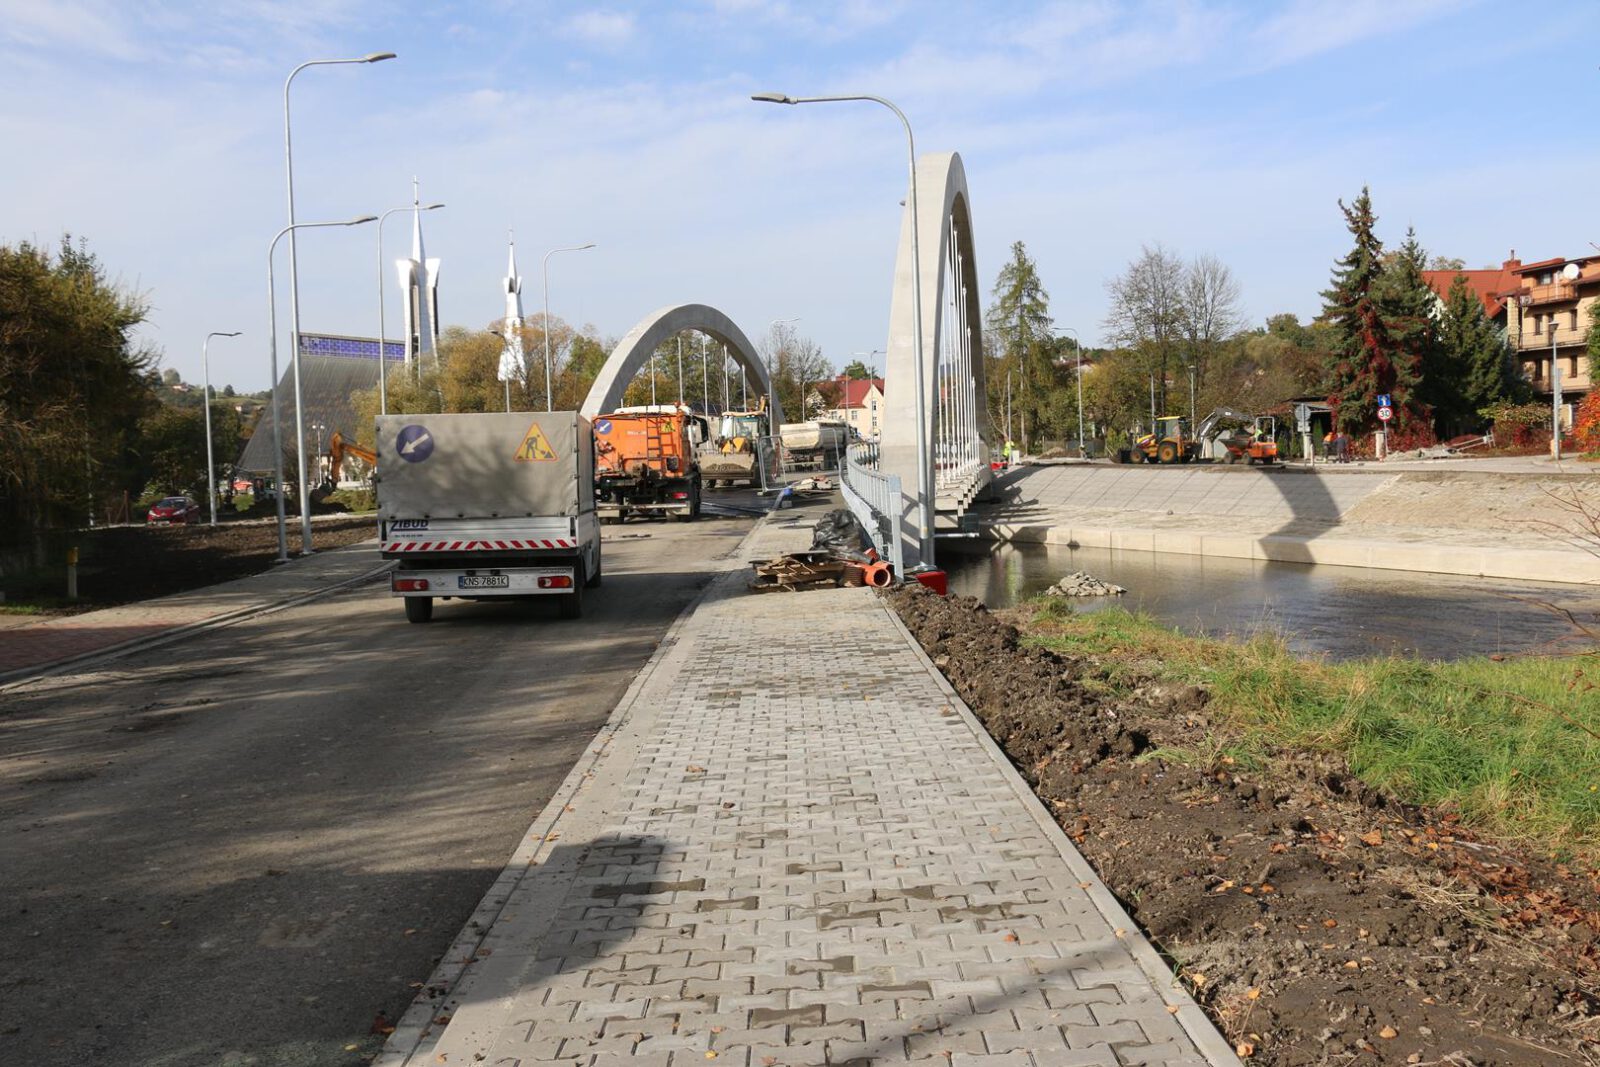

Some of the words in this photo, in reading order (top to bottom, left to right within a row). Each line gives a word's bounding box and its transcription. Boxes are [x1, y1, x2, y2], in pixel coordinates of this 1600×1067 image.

[1379, 410, 1390, 418] 30
[390, 519, 429, 531] ZIBUD
[464, 577, 479, 586] KNS
